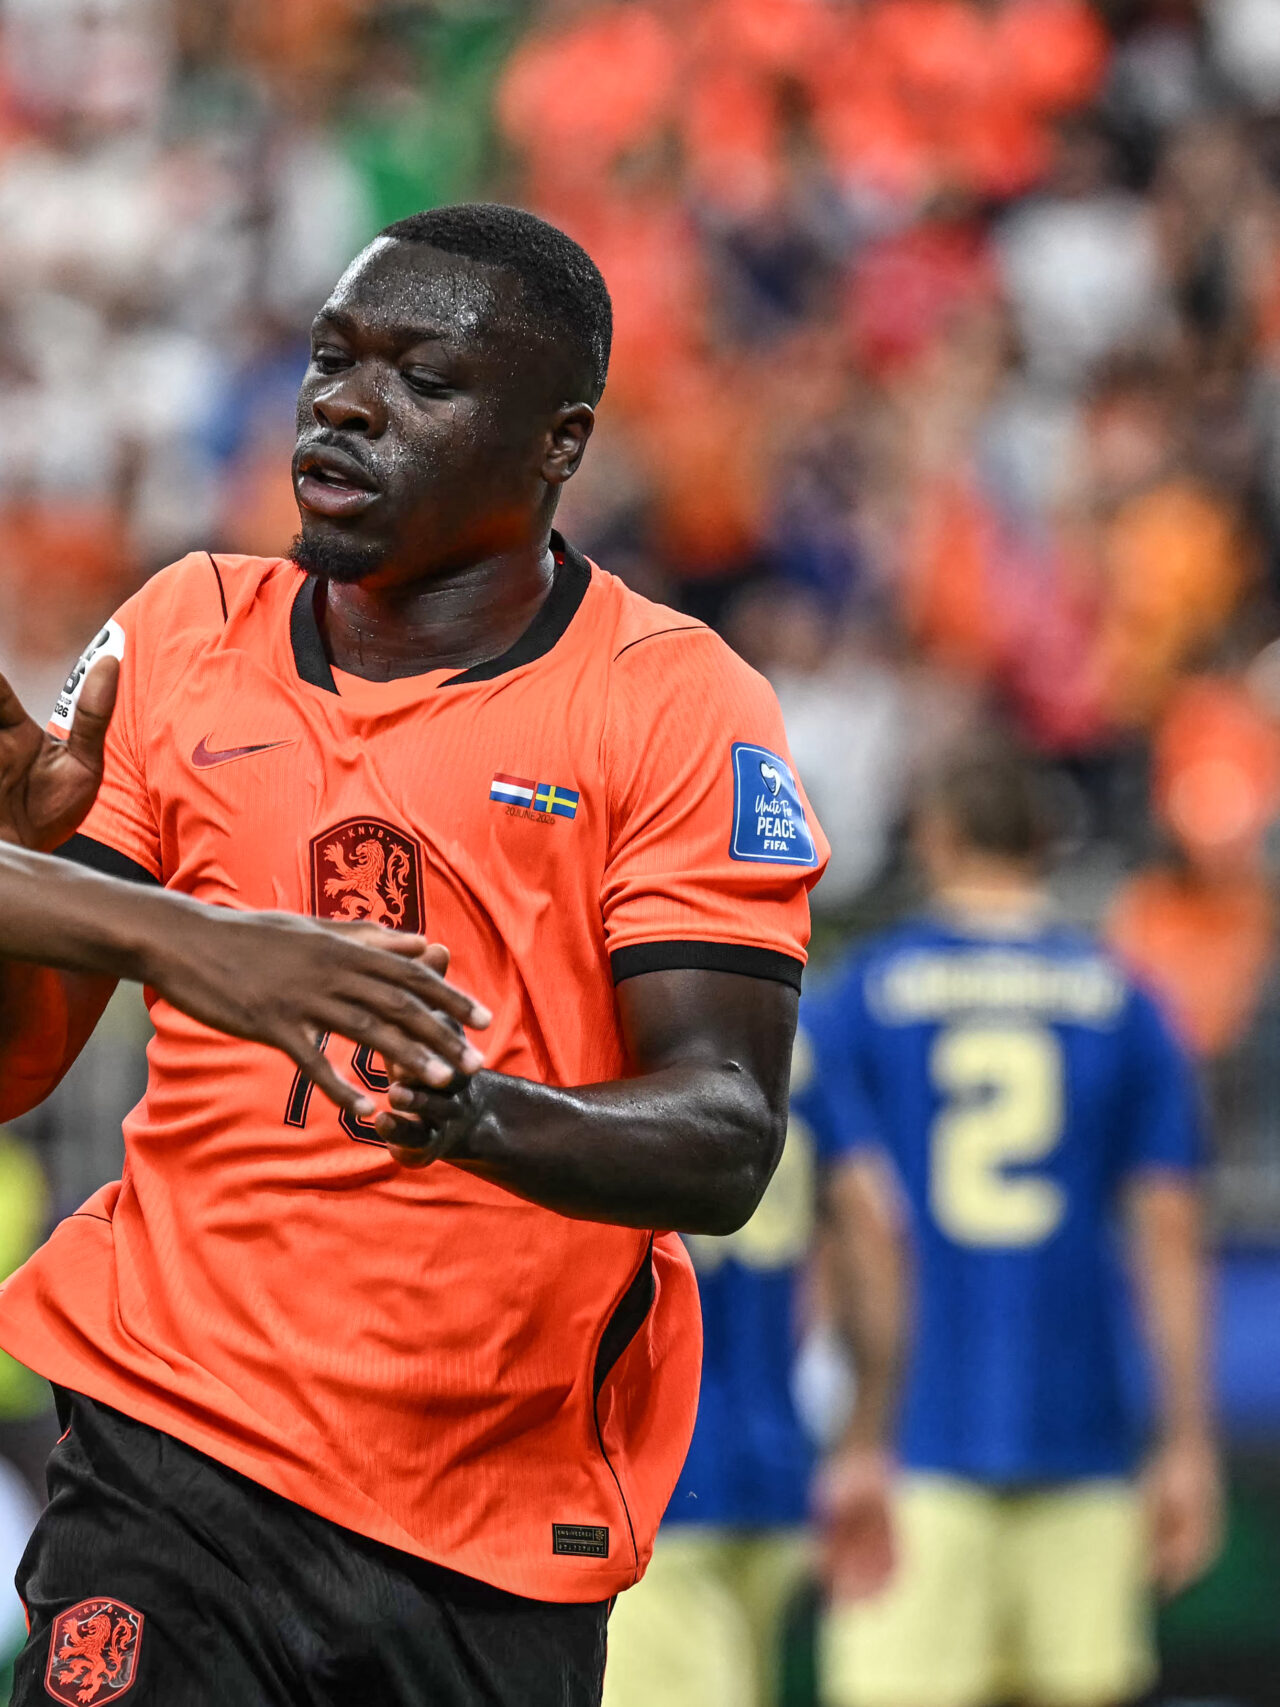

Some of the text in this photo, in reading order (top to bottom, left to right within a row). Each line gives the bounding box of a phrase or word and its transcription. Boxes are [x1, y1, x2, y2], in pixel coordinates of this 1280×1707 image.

[755, 794, 781, 816] Unite
[348, 826, 384, 838] KNVB
[757, 816, 796, 839] PEACE
[763, 840, 789, 851] FIFA
[929, 1023, 1066, 1250] 2
